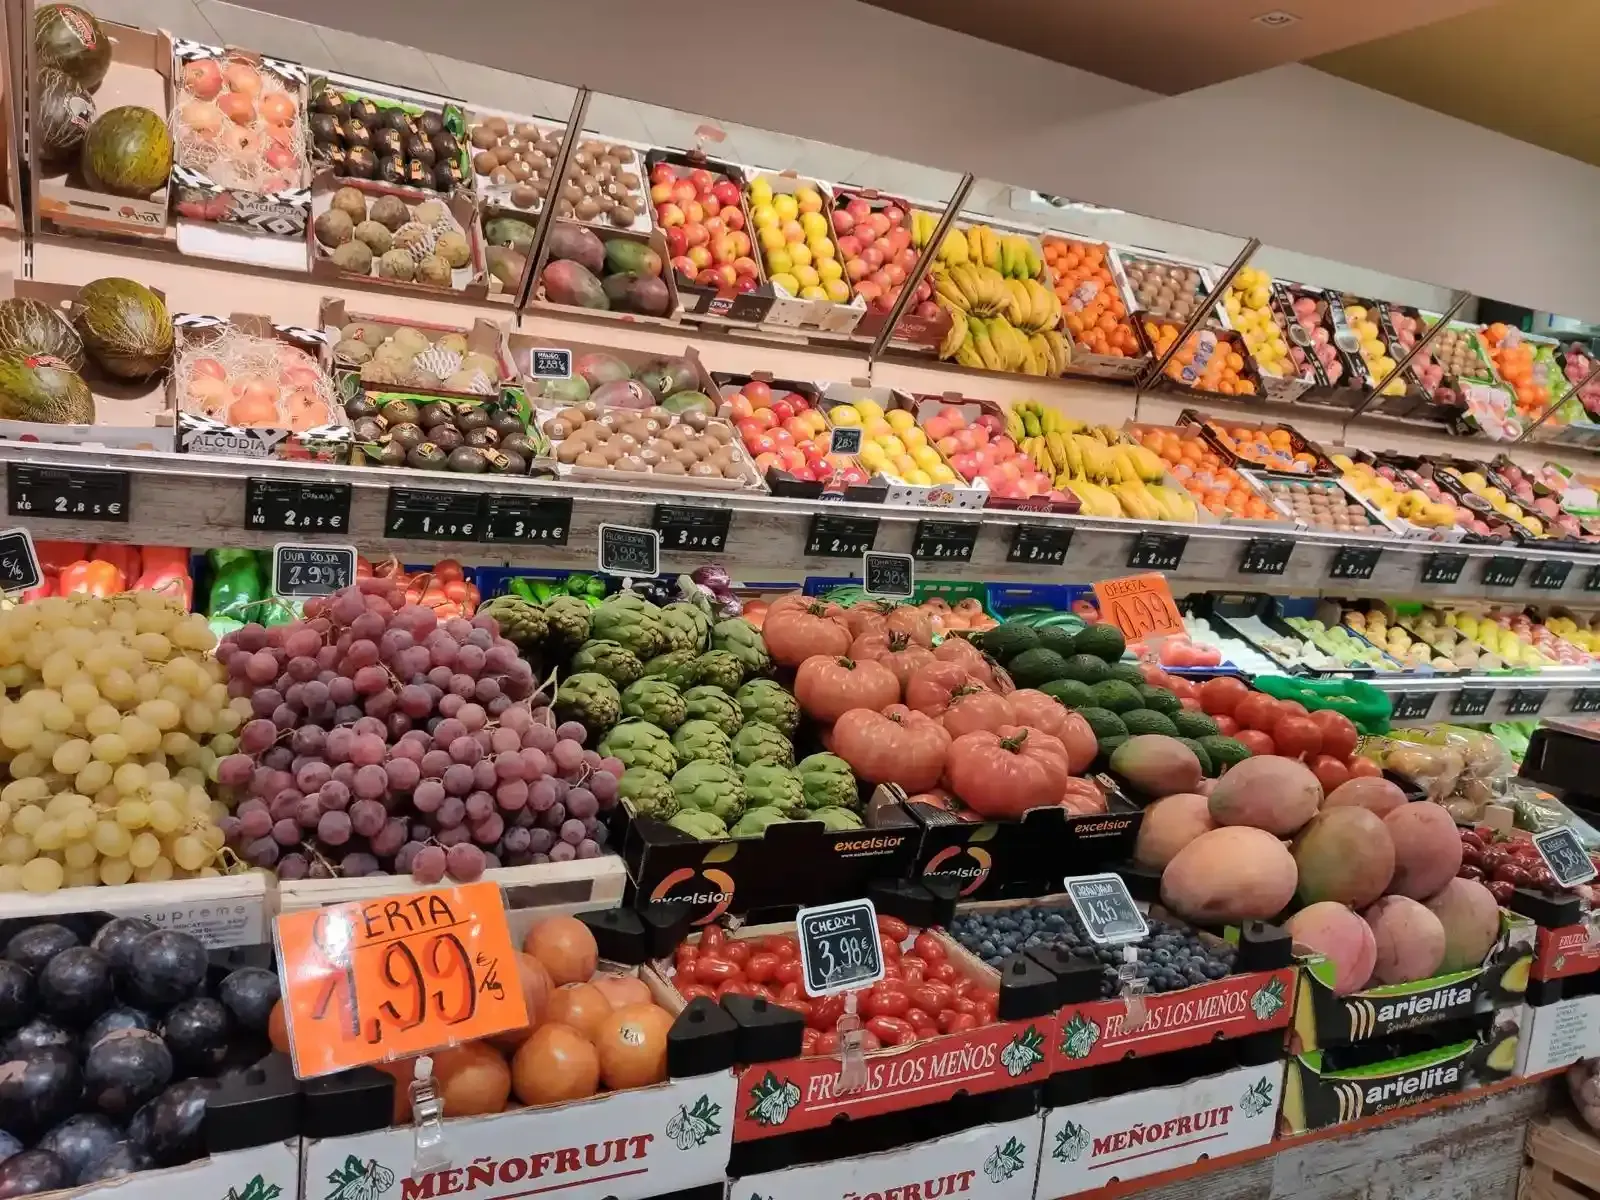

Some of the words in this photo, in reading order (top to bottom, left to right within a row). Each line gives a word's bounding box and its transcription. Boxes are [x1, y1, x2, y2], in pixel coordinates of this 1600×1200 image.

[192, 435, 266, 451] ALCUDIA
[16, 501, 32, 510] KG
[21, 493, 26, 501] 1
[252, 515, 265, 524] KG
[283, 551, 305, 561] UVA
[310, 551, 340, 562] ROSA
[1104, 580, 1148, 597] OFERTA
[1074, 820, 1132, 833] excelsior
[834, 837, 905, 852] excelsior
[144, 905, 245, 924] supreme
[311, 932, 477, 1045] 1,99
[1103, 1006, 1164, 1040] FRAS
[1164, 1000, 1197, 1025] LOS
[1195, 989, 1249, 1020] MEÑOS
[1377, 988, 1472, 1023] arielita
[805, 1063, 884, 1102] FRUAS
[888, 1057, 926, 1088] LOS
[928, 1040, 998, 1078] MEÑOS
[1365, 1067, 1459, 1104] arielita
[1091, 1105, 1234, 1158] MEÑOFRUIT
[400, 1133, 655, 1200] MEÑOFRUIT
